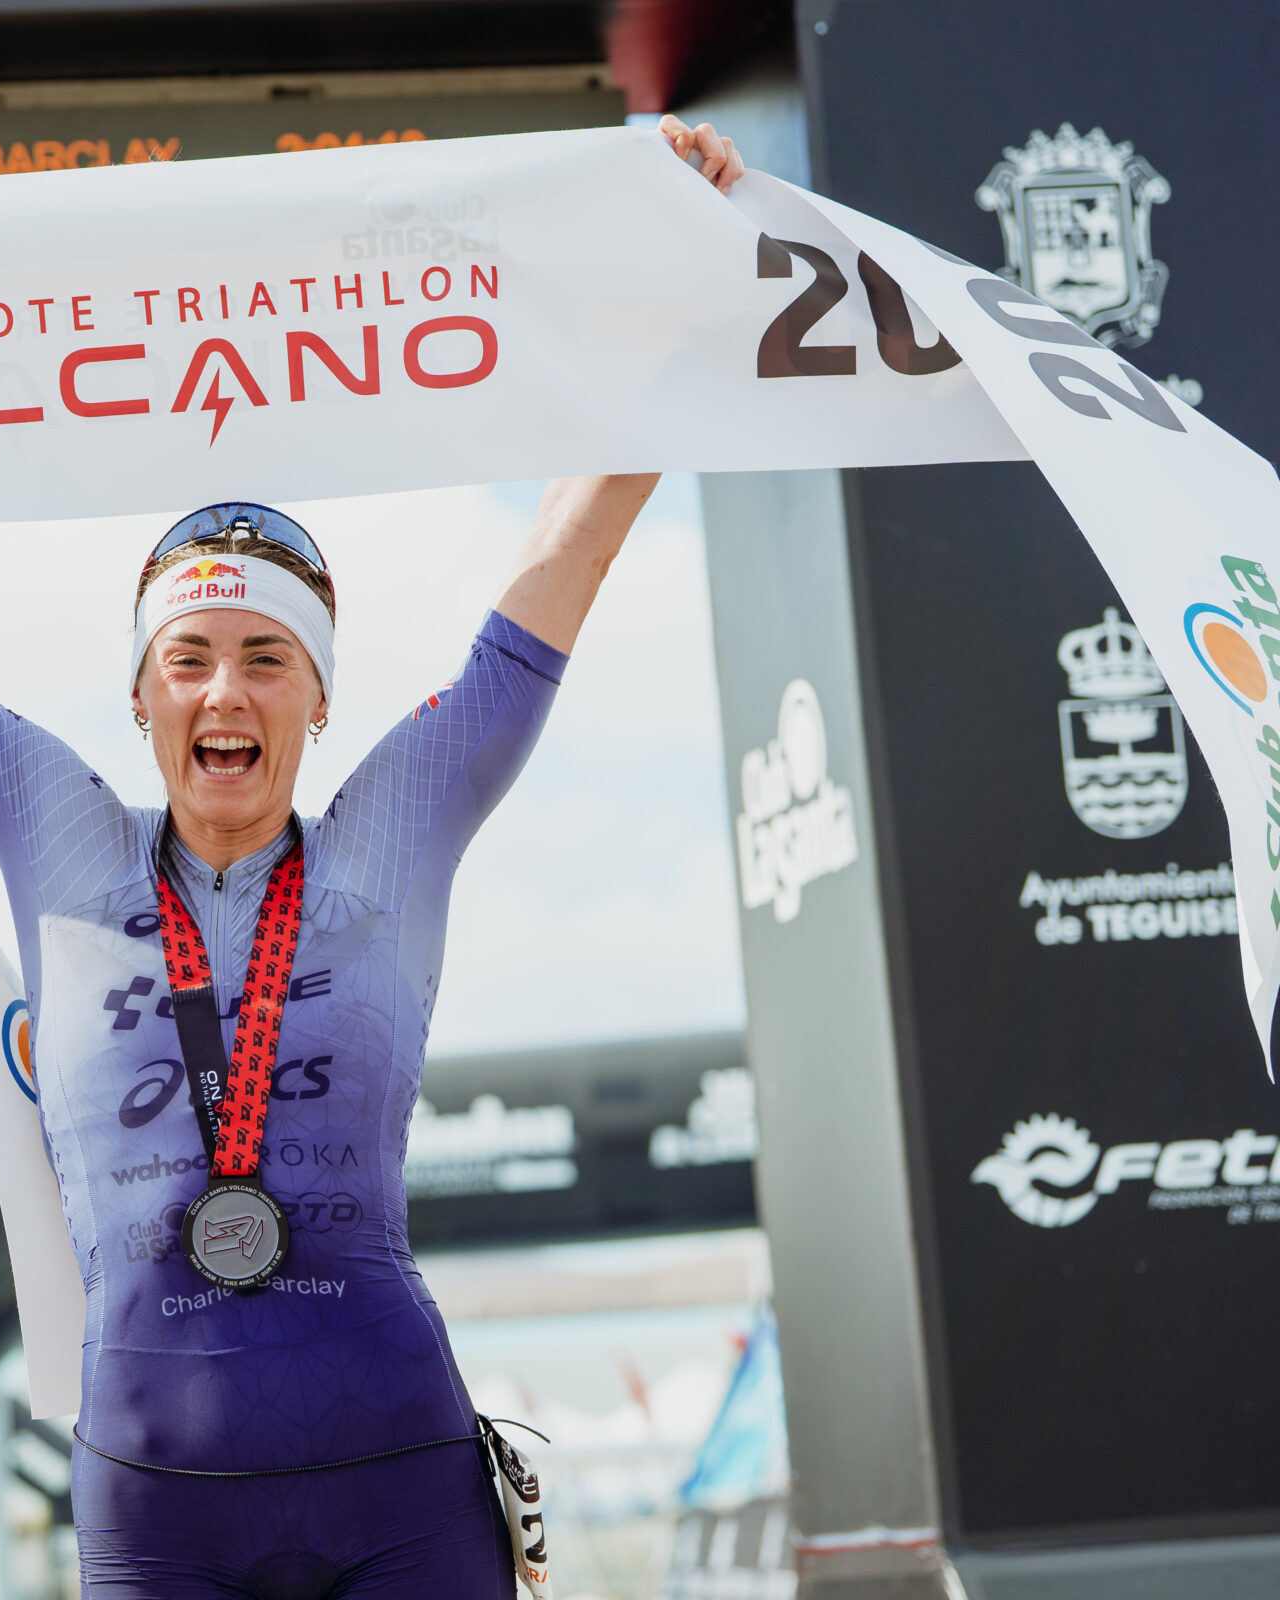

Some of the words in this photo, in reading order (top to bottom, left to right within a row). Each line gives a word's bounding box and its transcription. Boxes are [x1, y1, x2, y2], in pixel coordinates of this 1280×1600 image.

[134, 264, 498, 325] TRIATHLON
[206, 583, 246, 599] Bull
[1035, 905, 1083, 945] de
[1085, 897, 1240, 942] TEGUISE
[199, 1071, 215, 1122] TRIATHLON
[229, 1185, 257, 1195] VOLCANO
[258, 1191, 282, 1218] TRIATHLON
[128, 1219, 162, 1240] Club
